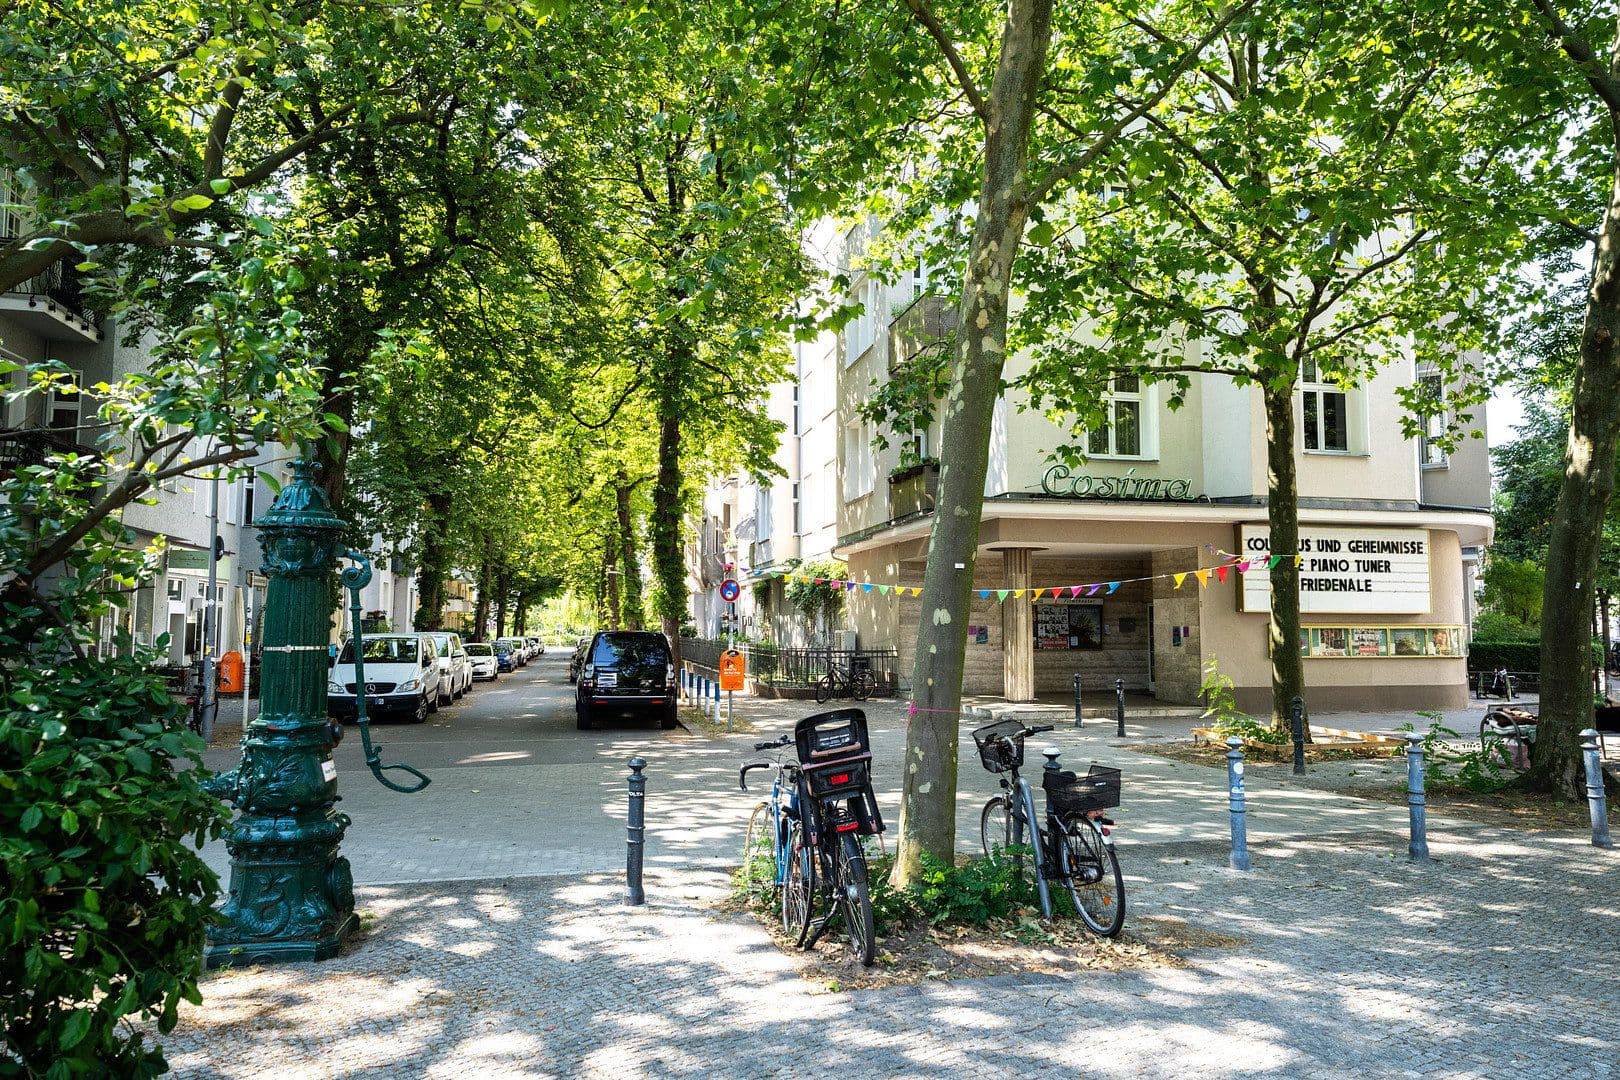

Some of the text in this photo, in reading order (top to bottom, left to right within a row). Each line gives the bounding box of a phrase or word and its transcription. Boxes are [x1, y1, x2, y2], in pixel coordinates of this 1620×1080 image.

[1041, 464, 1194, 499] Cosima
[1247, 537, 1424, 555] COUUS UND GEHEIMNISSE
[1310, 558, 1349, 573] PIANO
[1354, 559, 1391, 573] TUNER
[1300, 577, 1372, 592] FRIEDENALE
